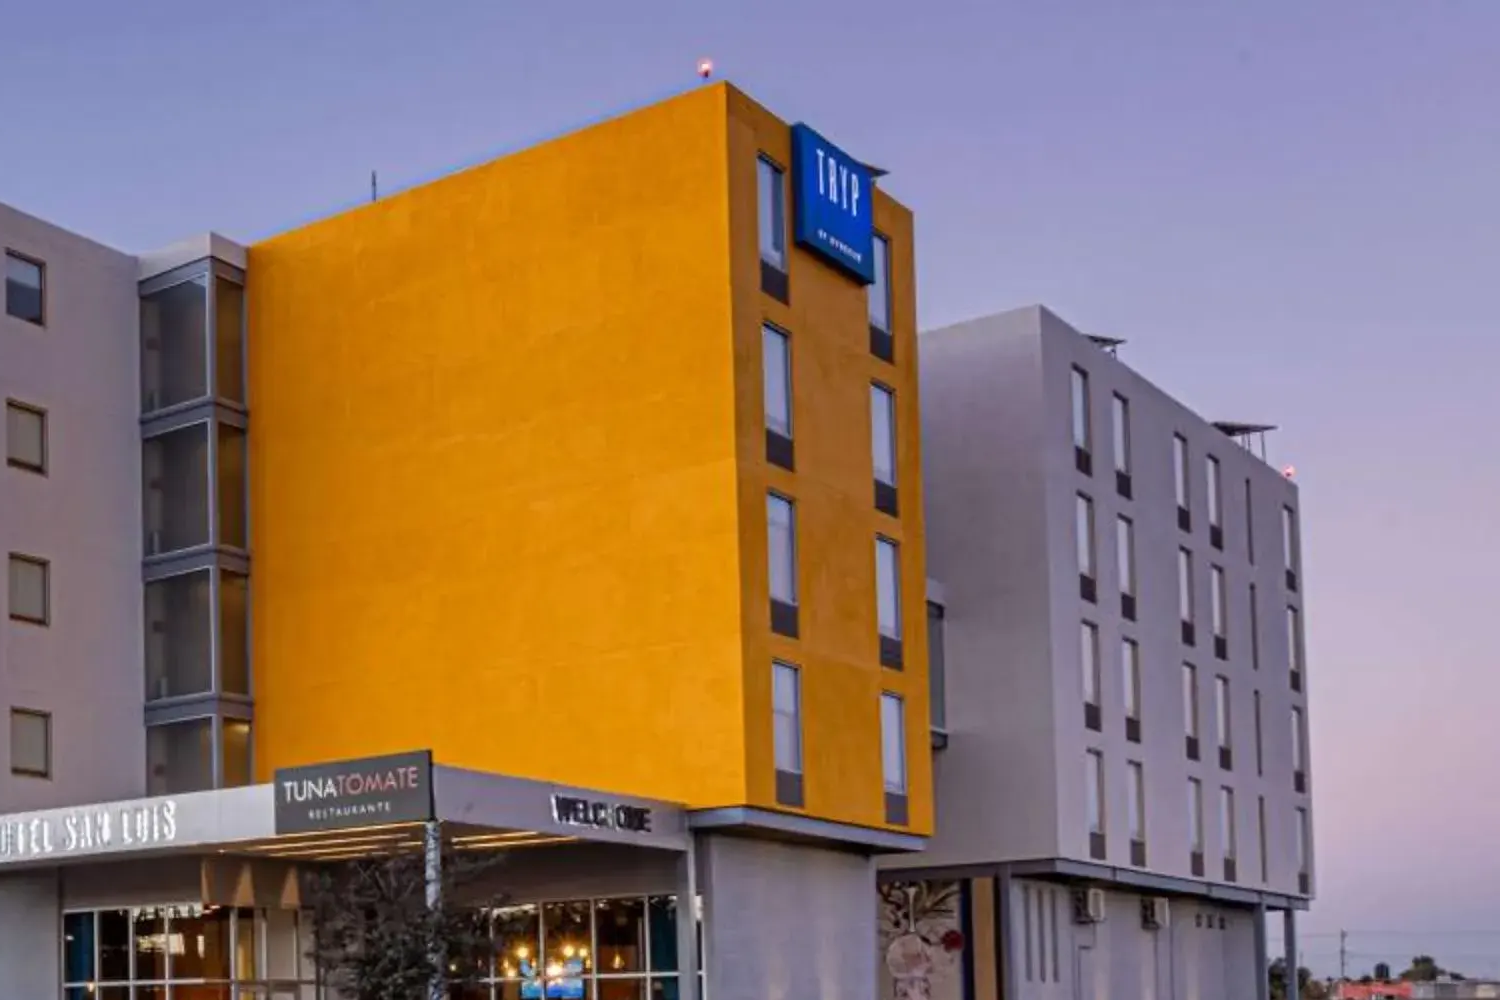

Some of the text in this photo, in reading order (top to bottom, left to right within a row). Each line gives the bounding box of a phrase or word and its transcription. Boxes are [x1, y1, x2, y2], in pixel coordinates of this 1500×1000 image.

[816, 148, 860, 217] TRYP
[283, 766, 419, 803] TUNATOMATE
[64, 811, 111, 851] SAN
[121, 799, 177, 844] LUIS
[308, 801, 391, 820] RESTAURANTE
